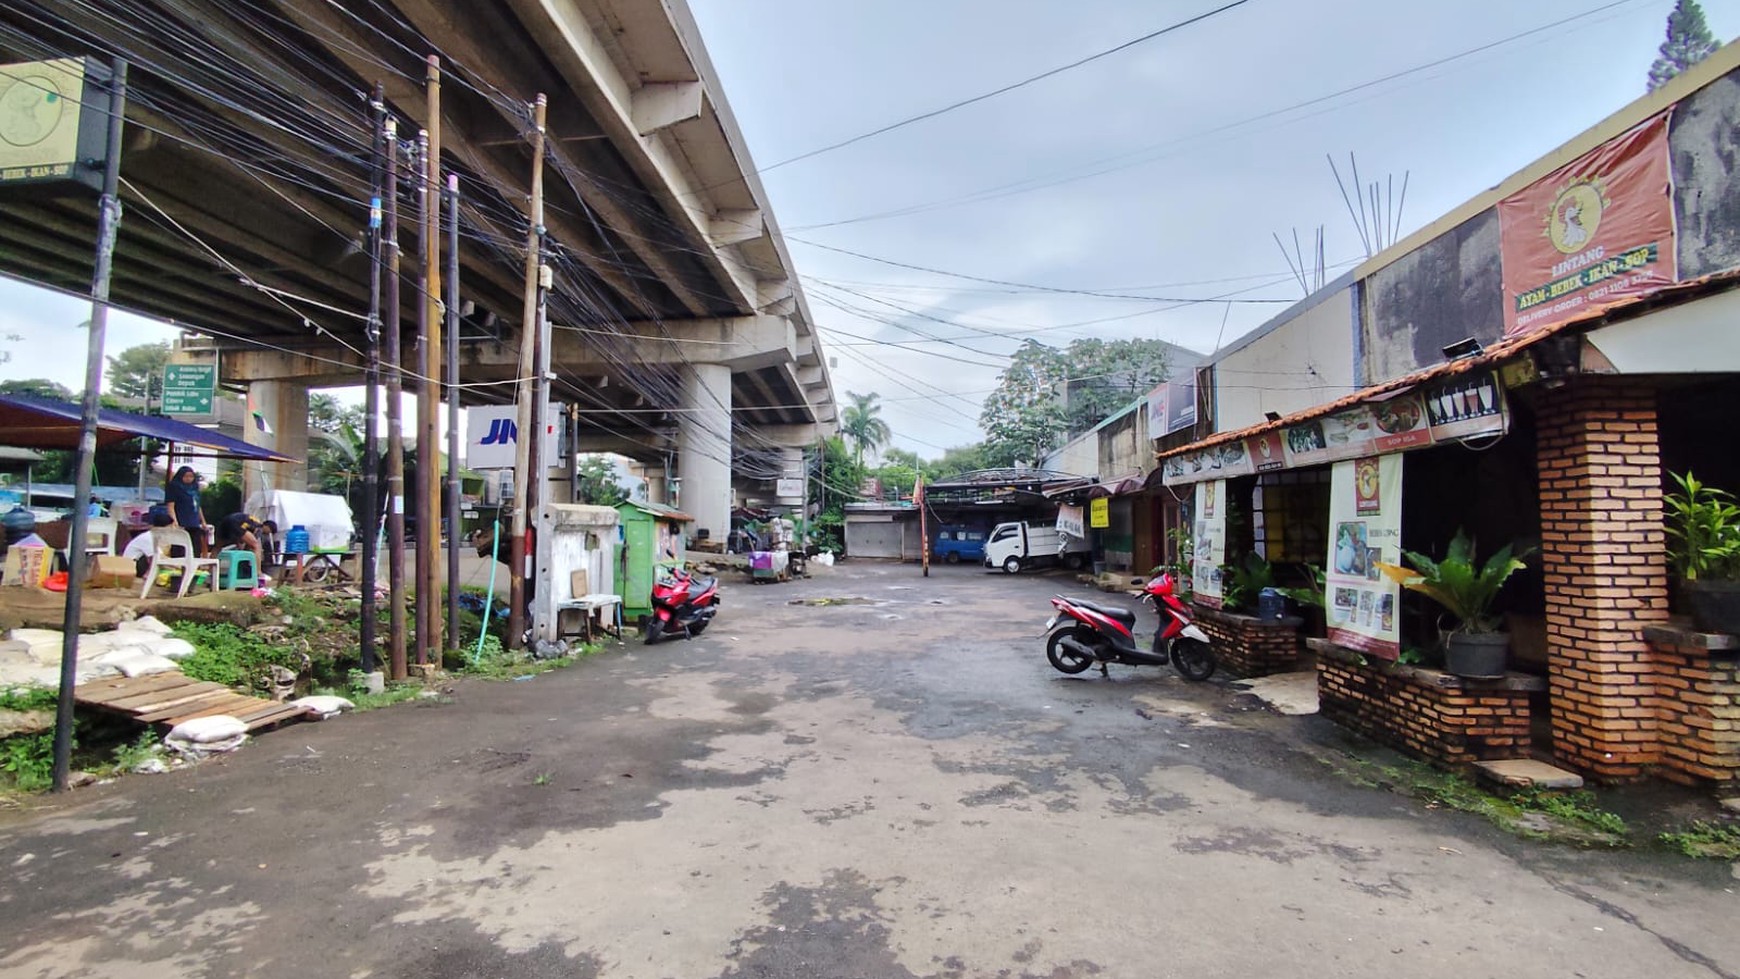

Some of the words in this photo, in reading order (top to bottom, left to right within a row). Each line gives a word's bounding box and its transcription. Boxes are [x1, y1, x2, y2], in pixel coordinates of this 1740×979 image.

[1520, 289, 1545, 309] AYAM
[1550, 275, 1583, 298] BEBEK
[1589, 260, 1617, 283] IKAN
[1625, 248, 1649, 270] SOP
[1552, 246, 1604, 276] LINTANG
